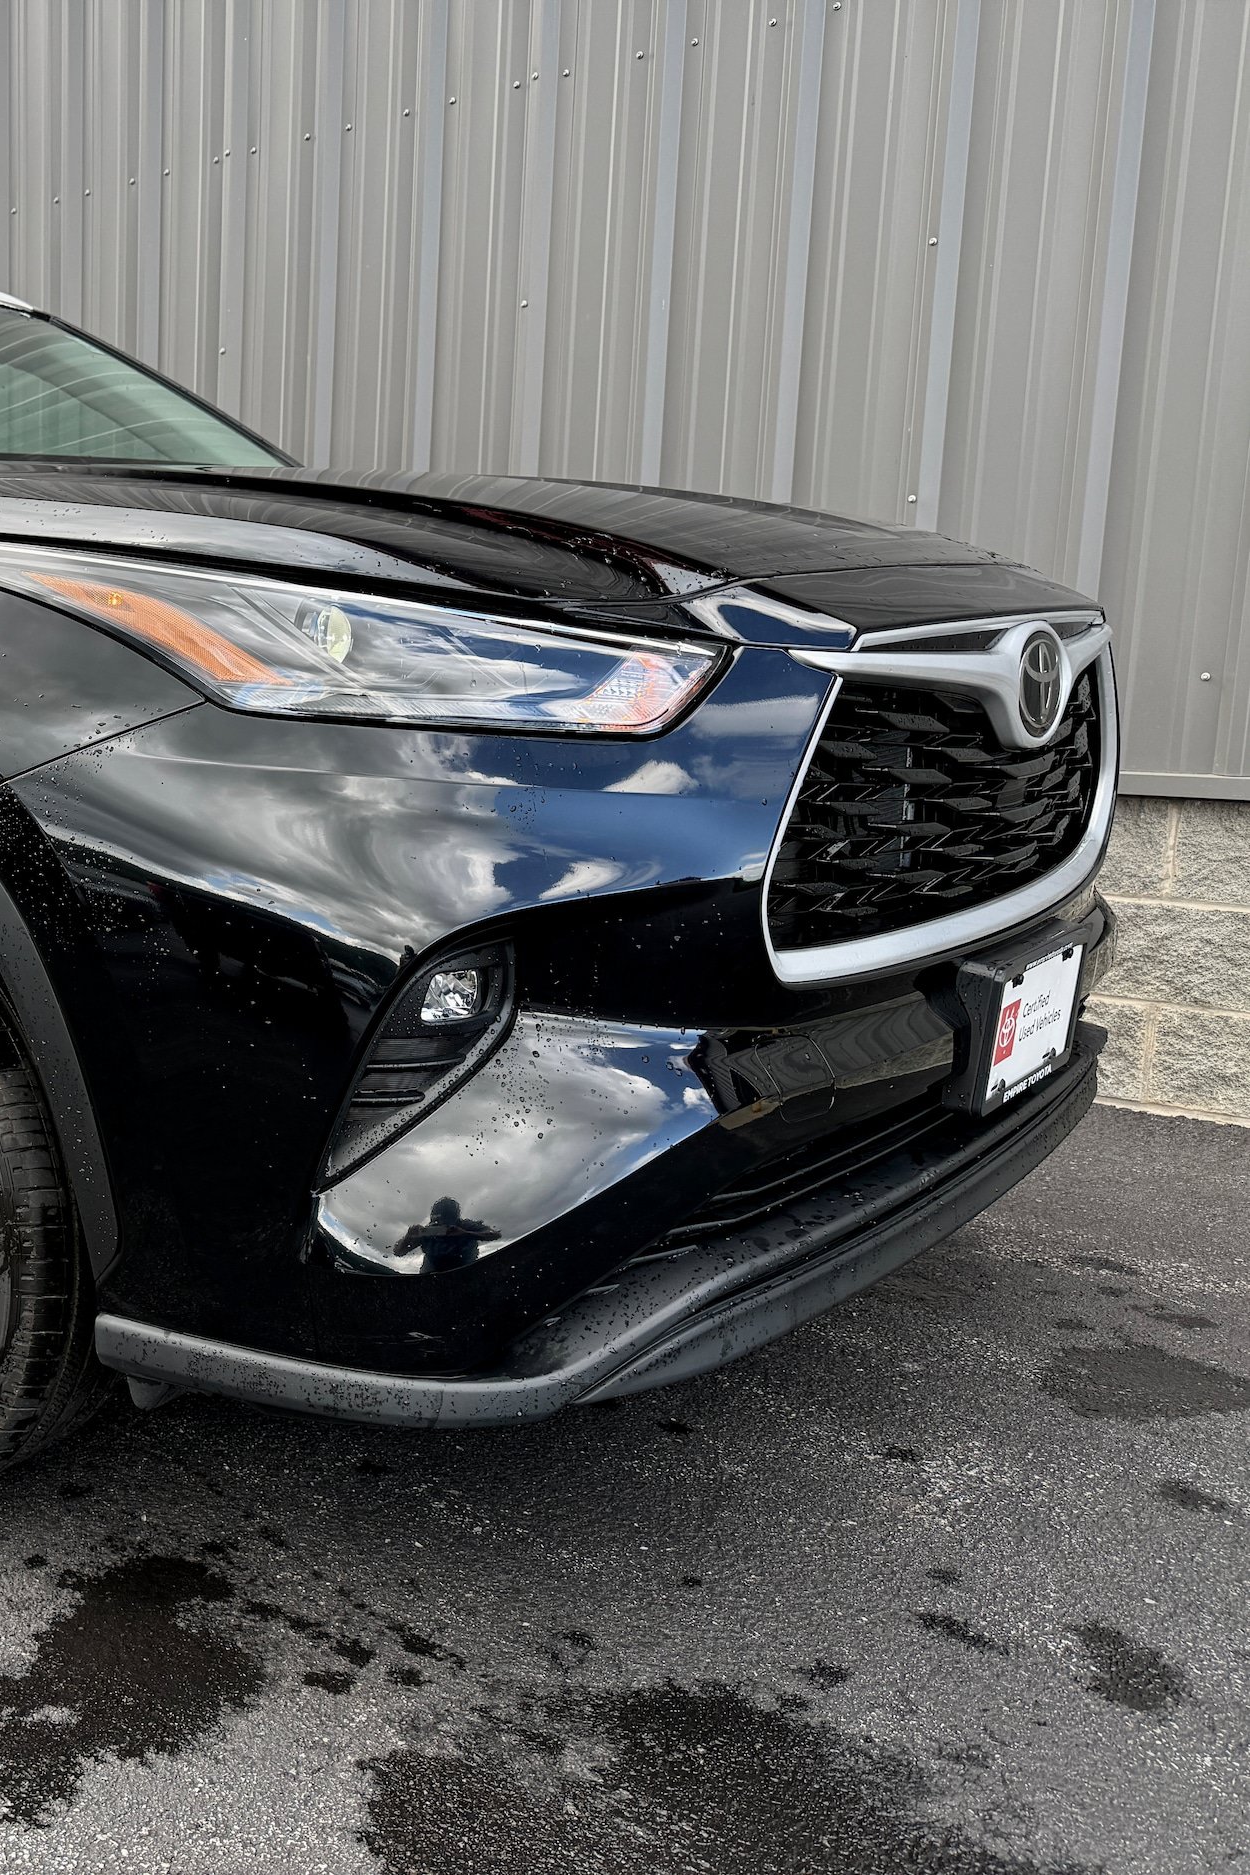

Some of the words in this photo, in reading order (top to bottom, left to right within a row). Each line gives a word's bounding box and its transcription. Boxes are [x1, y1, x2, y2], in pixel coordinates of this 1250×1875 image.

[1022, 989, 1051, 1018] Certified
[1018, 1022, 1035, 1042] Used
[1033, 1008, 1062, 1032] Vehicles
[1002, 1078, 1028, 1103] EMPIRE
[1027, 1064, 1052, 1087] TOYOTA
